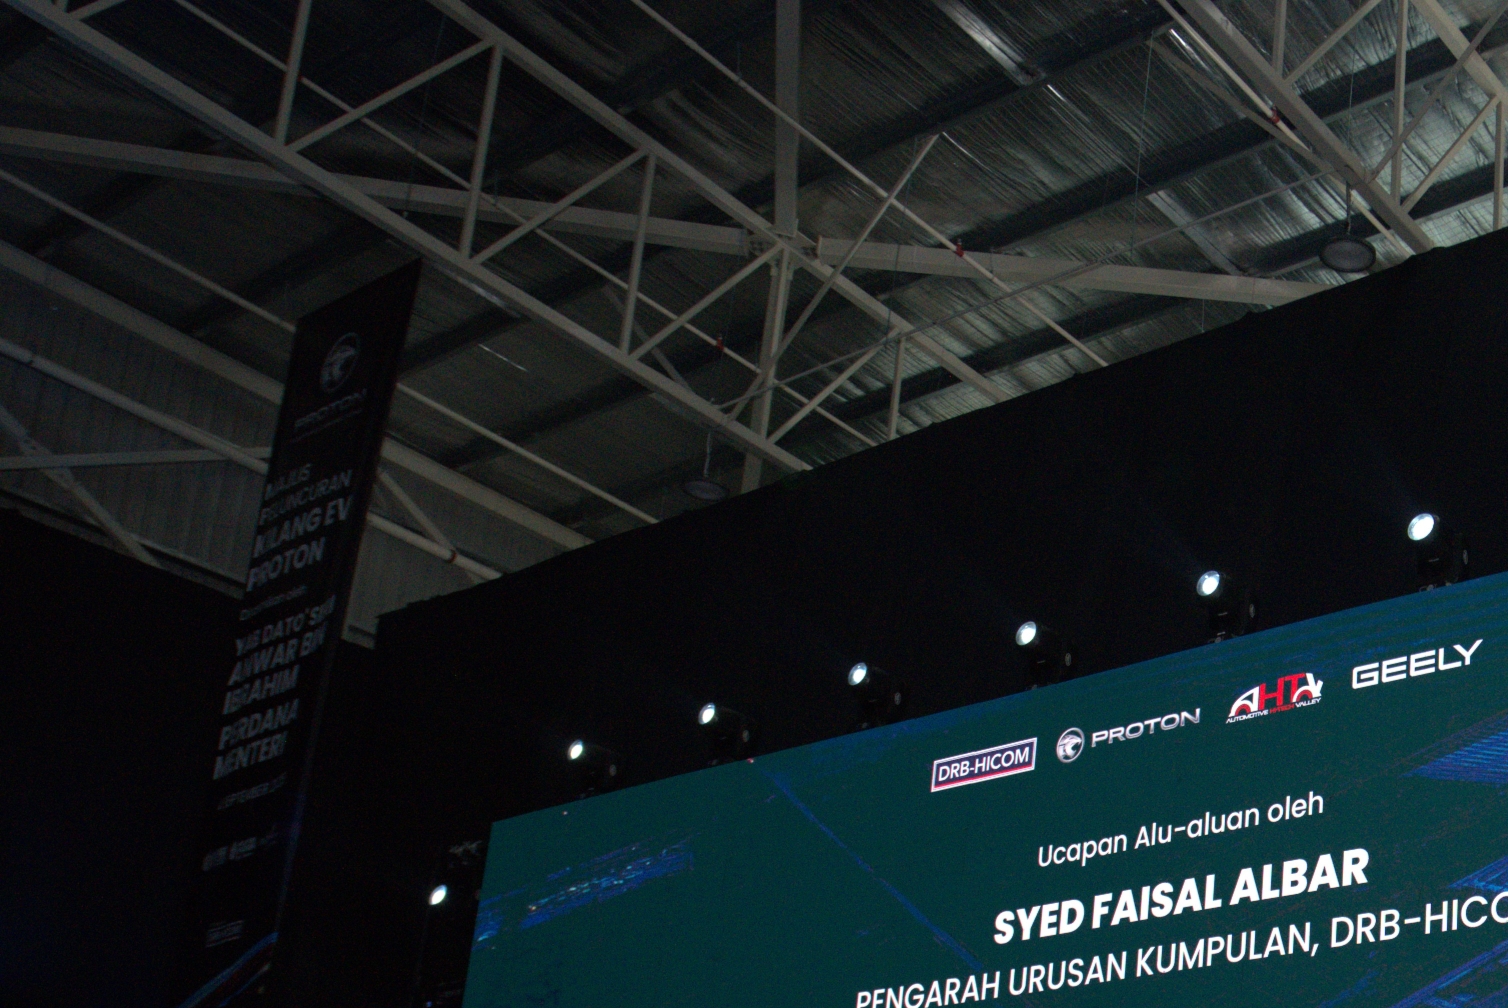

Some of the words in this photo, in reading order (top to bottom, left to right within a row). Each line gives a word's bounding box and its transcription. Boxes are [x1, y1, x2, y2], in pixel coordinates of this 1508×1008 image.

[323, 494, 354, 526] EV
[246, 536, 326, 591] PROTON
[1352, 639, 1483, 689] GEELY
[1091, 698, 1201, 748] PROTON
[1226, 710, 1269, 724] AUTOMOTIVE
[1295, 697, 1322, 708] VALLEY
[939, 747, 1030, 782] DRB-HICOM
[1039, 837, 1128, 867] Ucapan
[1135, 808, 1260, 850] Alu-aluan
[1268, 791, 1324, 823] oleh
[994, 900, 1086, 944] SYED
[1092, 875, 1223, 928] FAISAL
[1230, 848, 1370, 905] ALBAR
[1009, 952, 1127, 995] URUSAN
[1137, 922, 1319, 977] KUMPULAN,
